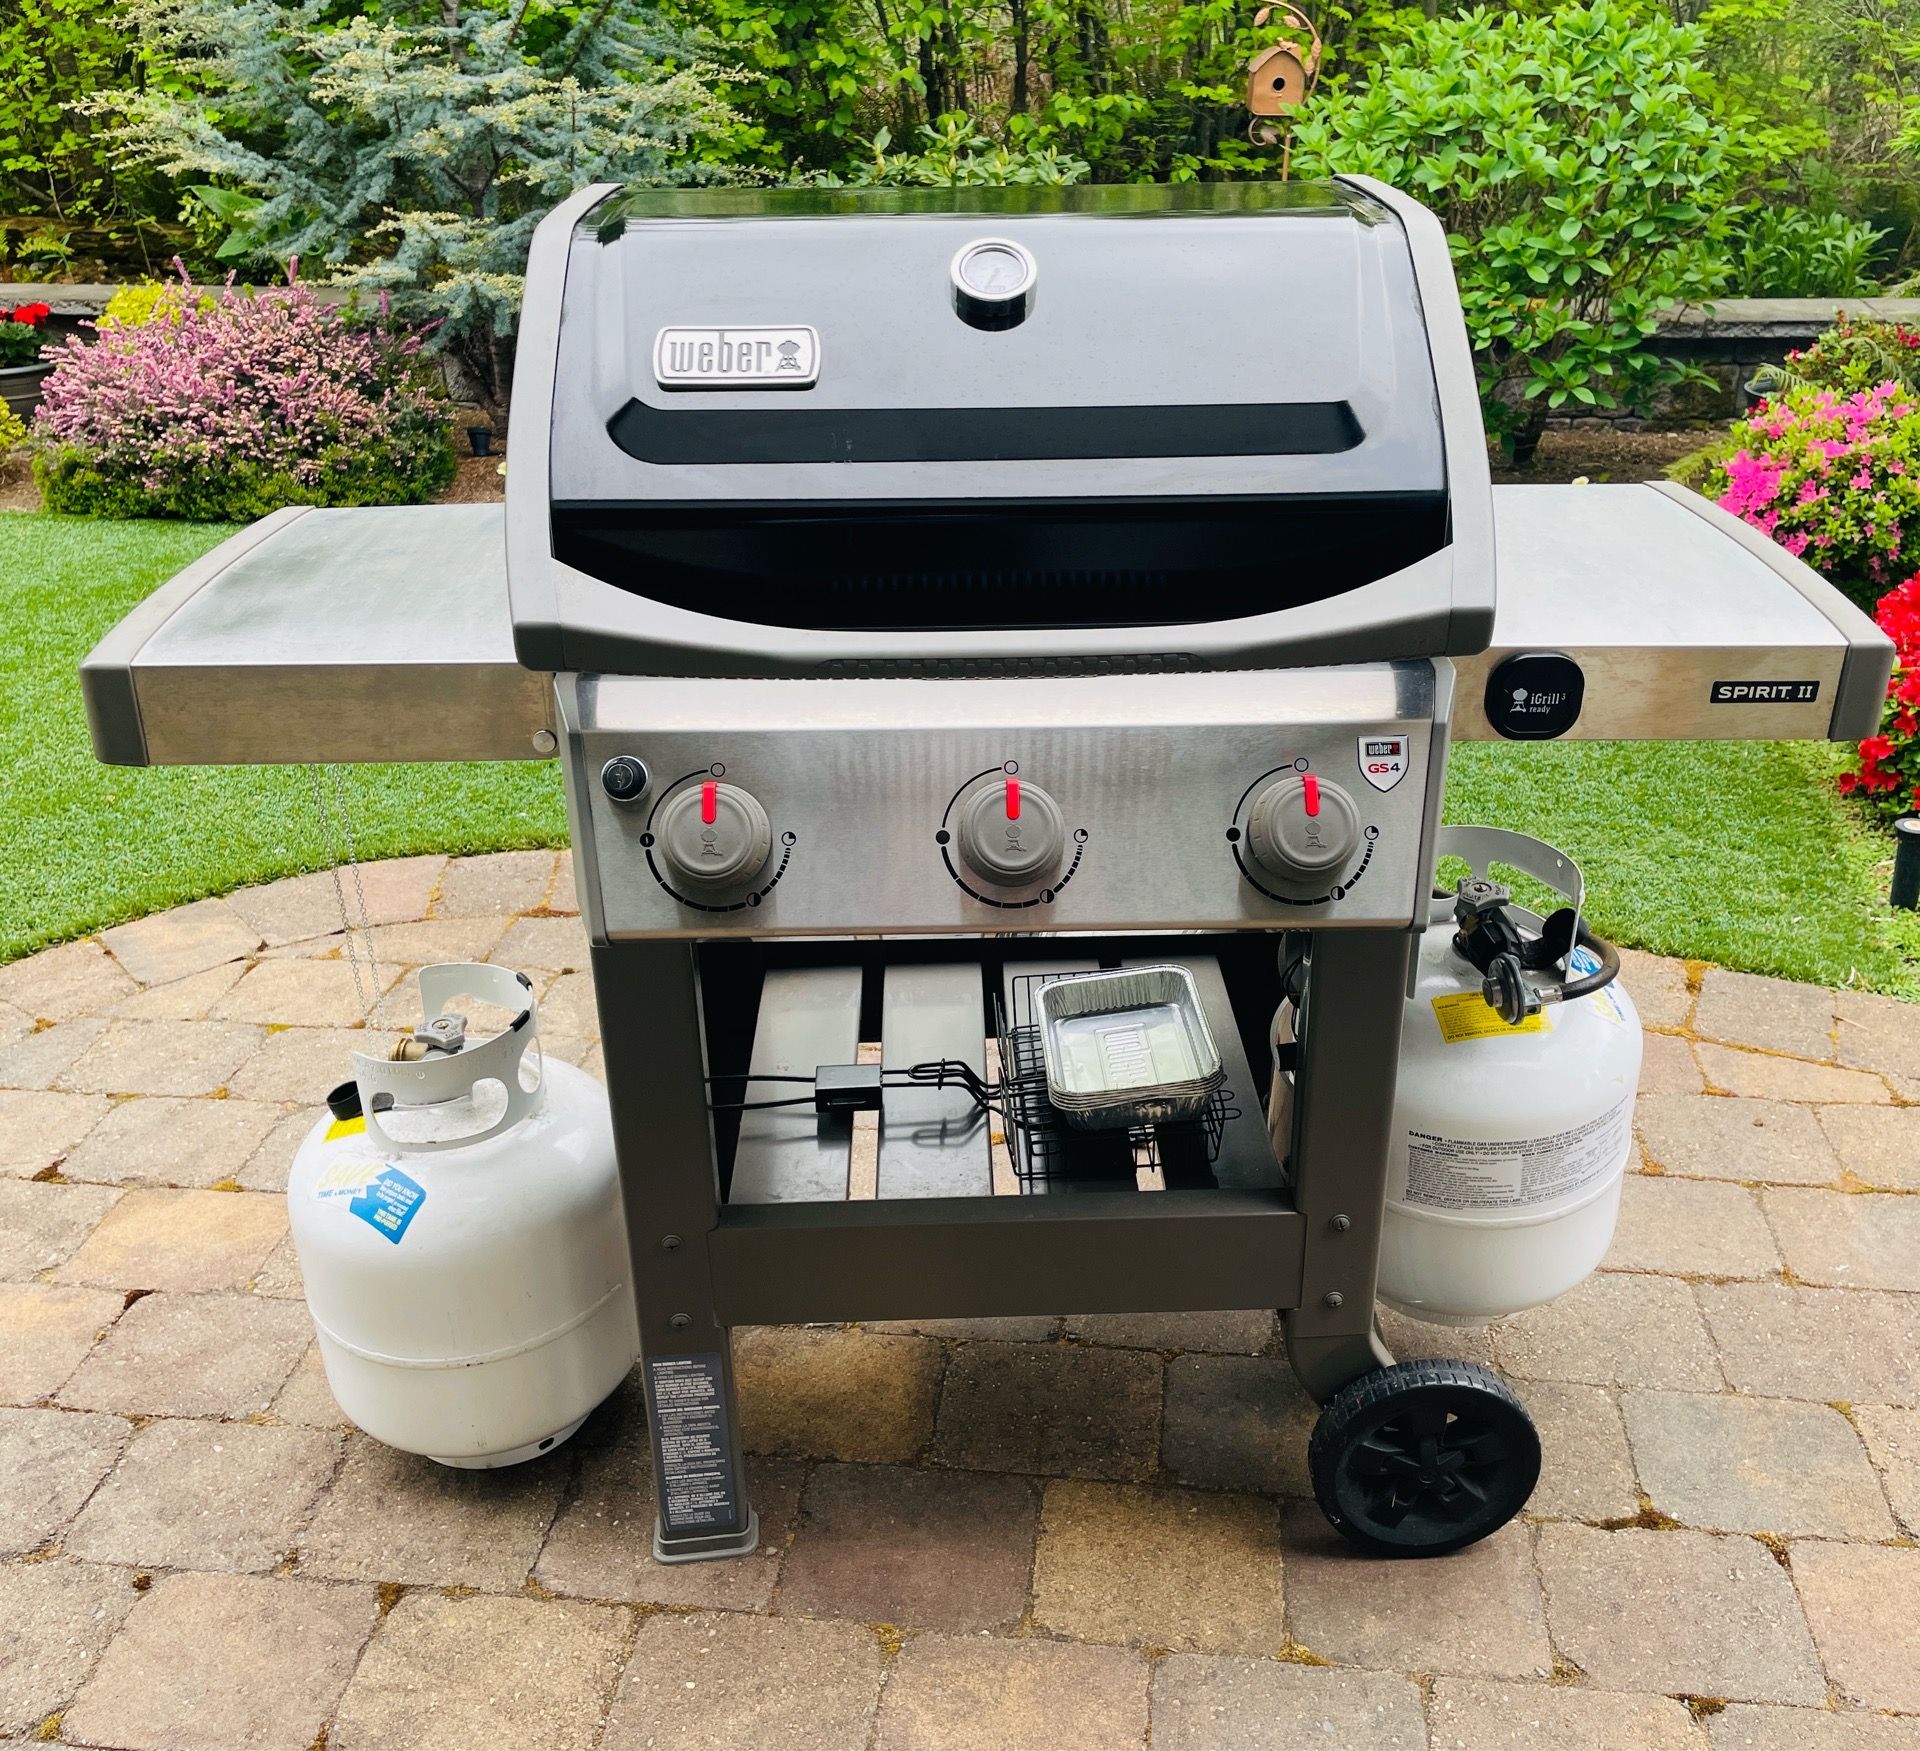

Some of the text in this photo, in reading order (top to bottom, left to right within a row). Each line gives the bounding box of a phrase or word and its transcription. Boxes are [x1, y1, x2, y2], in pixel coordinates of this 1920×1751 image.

[670, 331, 771, 373] weber
[1718, 686, 1813, 699] SPIRIT II
[1530, 693, 1560, 705] iGrill
[1529, 705, 1551, 714] ready
[1368, 742, 1392, 755] weber
[1368, 762, 1401, 773] GS4
[1408, 1130, 1443, 1142] DANGER
